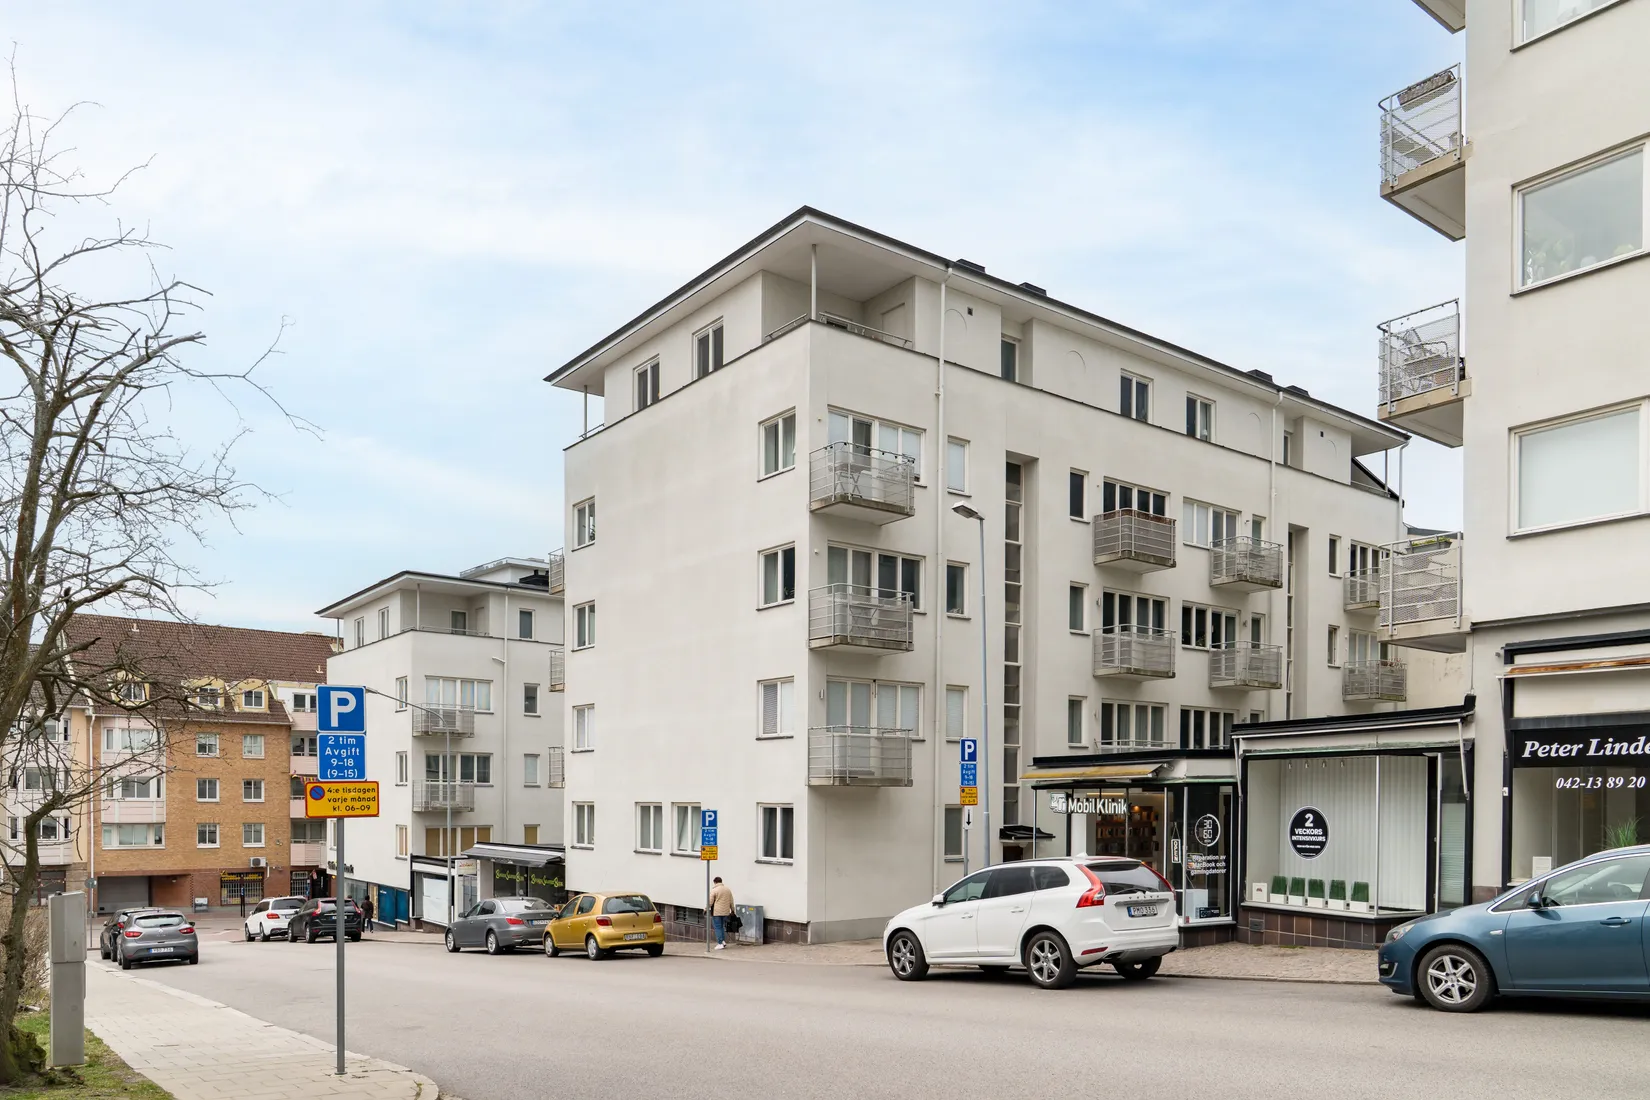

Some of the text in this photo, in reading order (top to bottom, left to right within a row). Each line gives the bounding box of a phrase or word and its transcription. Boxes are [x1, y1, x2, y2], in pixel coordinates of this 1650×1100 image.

[330, 690, 357, 728] P
[328, 736, 356, 745] 2 tim
[325, 747, 360, 758] Avgift
[964, 740, 975, 761] P
[1521, 740, 1584, 758] Peter
[330, 758, 354, 767] 9-18
[327, 768, 358, 779] (9-15)
[1555, 776, 1646, 789] 042-13 89 20
[342, 785, 376, 796] tisdagen
[327, 794, 376, 804] varje månad
[345, 804, 371, 812] 06-09
[1068, 798, 1128, 814] MobilKlinik
[705, 811, 715, 827] P
[1203, 820, 1213, 829] 30
[1304, 813, 1314, 827] 2
[1203, 829, 1213, 839] 60
